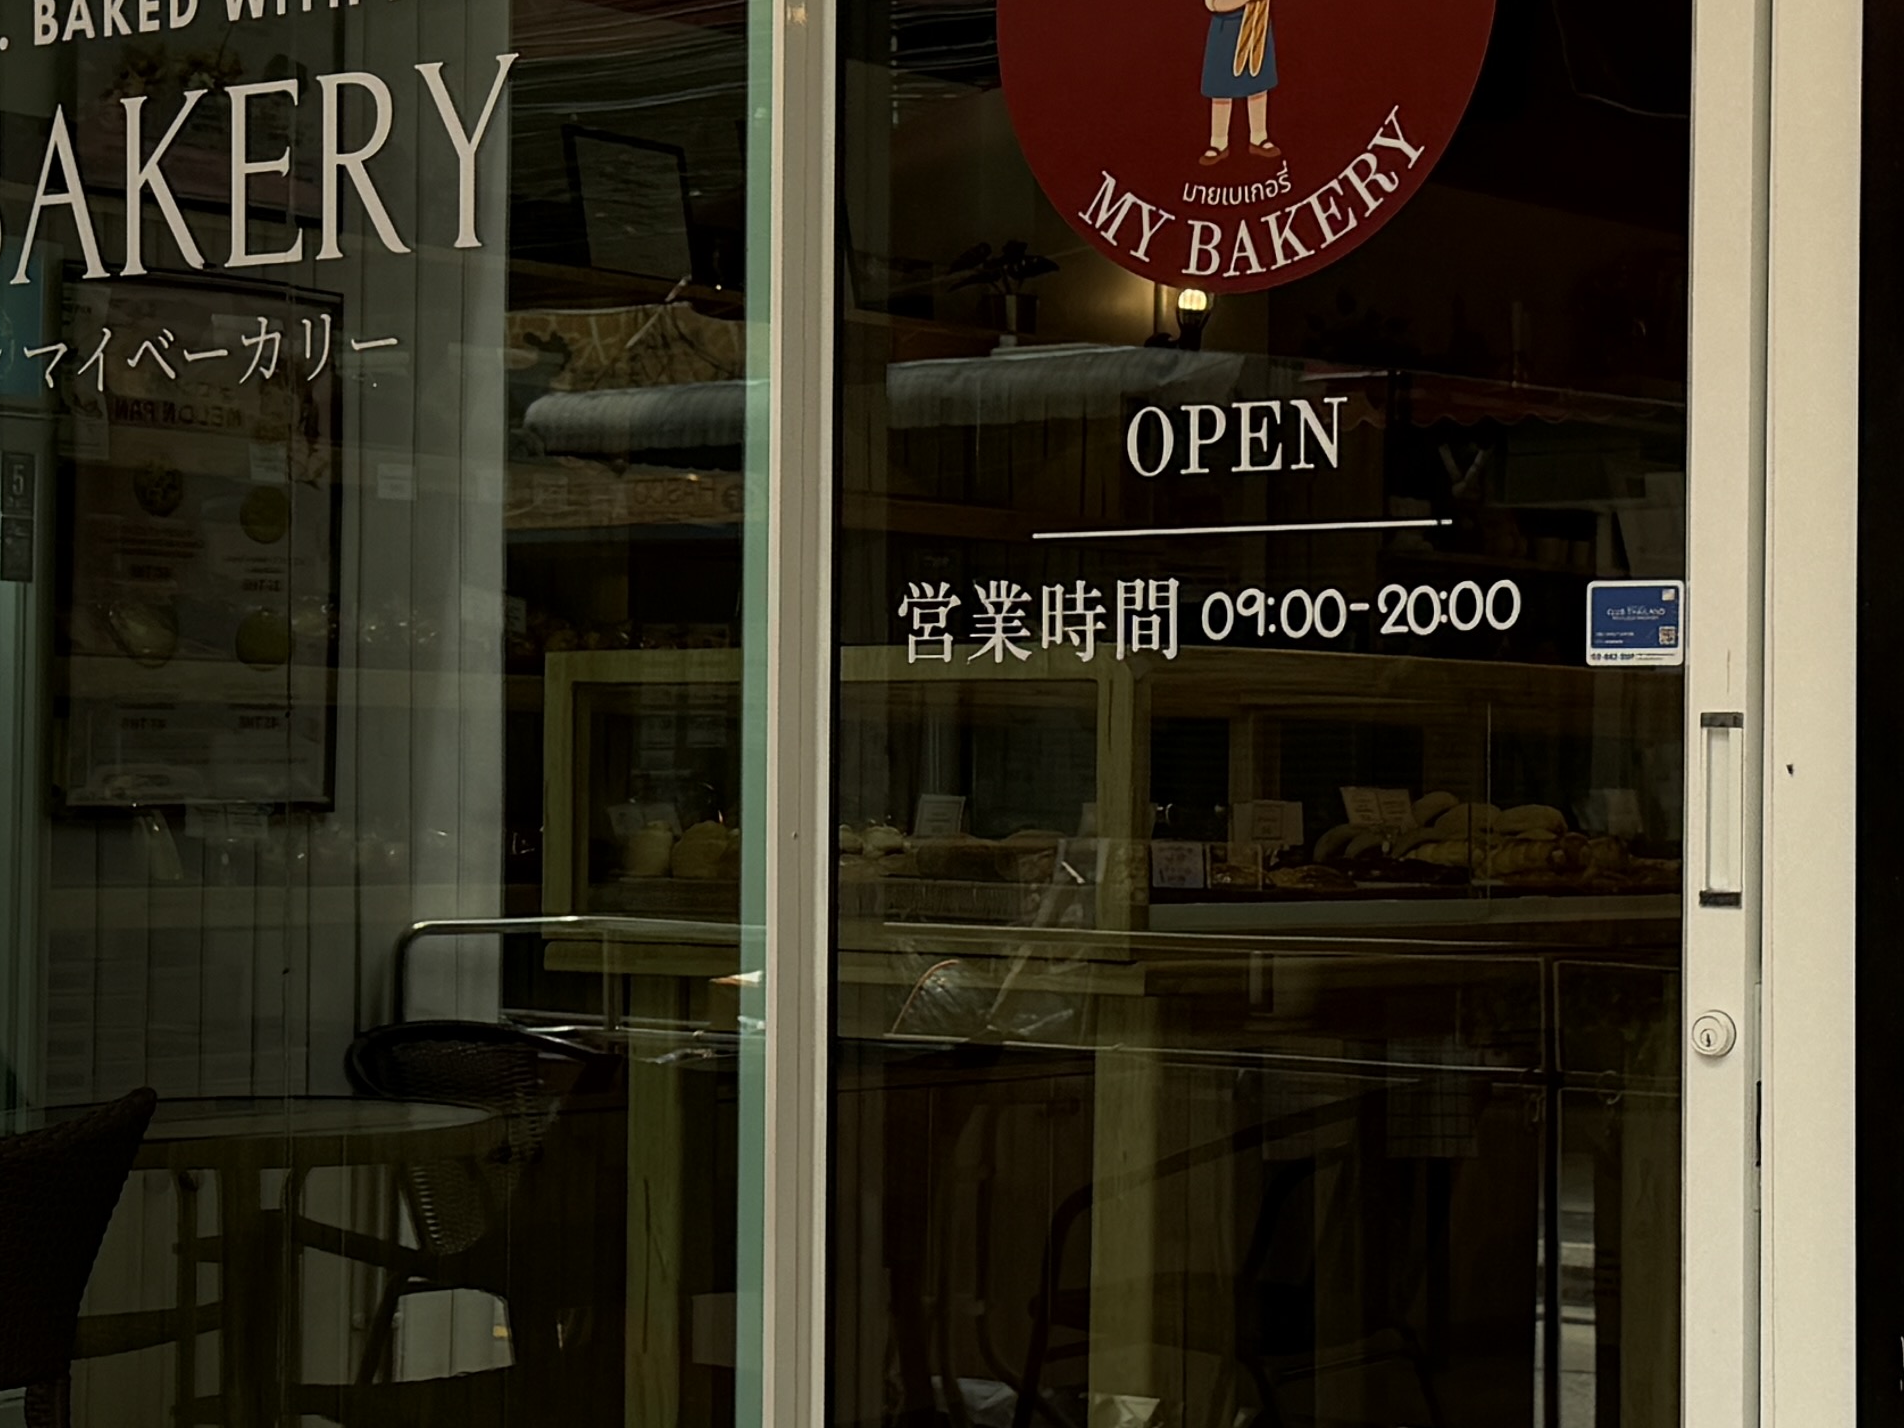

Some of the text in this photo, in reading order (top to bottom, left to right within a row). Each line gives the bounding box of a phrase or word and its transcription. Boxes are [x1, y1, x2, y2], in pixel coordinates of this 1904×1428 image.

[1078, 106, 1425, 277] MY BAKERY
[1182, 161, 1292, 206] มายเบเกอรี่
[24, 313, 398, 390] マイベーカリー
[1126, 397, 1348, 478] OPEN
[897, 578, 1522, 665] 営業時間 09:00-20:00
